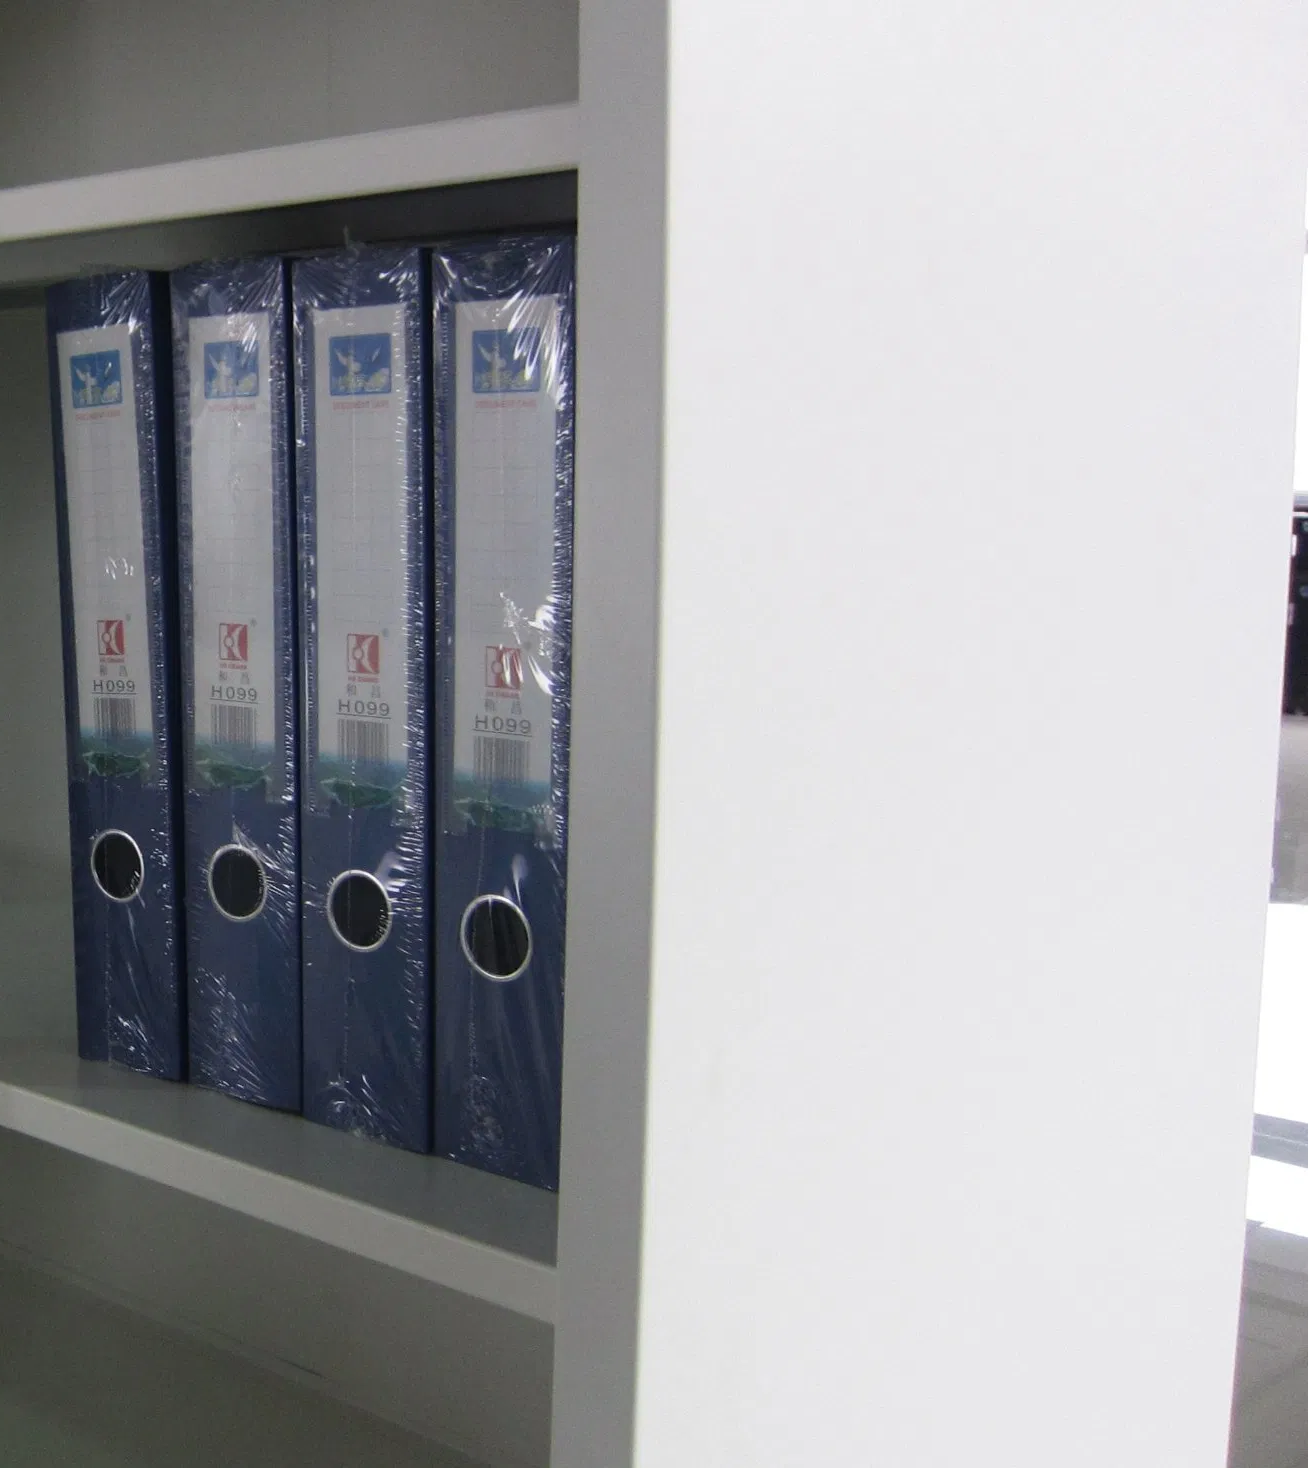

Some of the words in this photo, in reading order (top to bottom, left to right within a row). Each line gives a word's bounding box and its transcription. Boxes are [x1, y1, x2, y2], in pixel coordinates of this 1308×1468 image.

[93, 679, 135, 692] H099
[211, 685, 257, 701] H099
[338, 699, 390, 716] H099
[474, 713, 532, 734] H099
